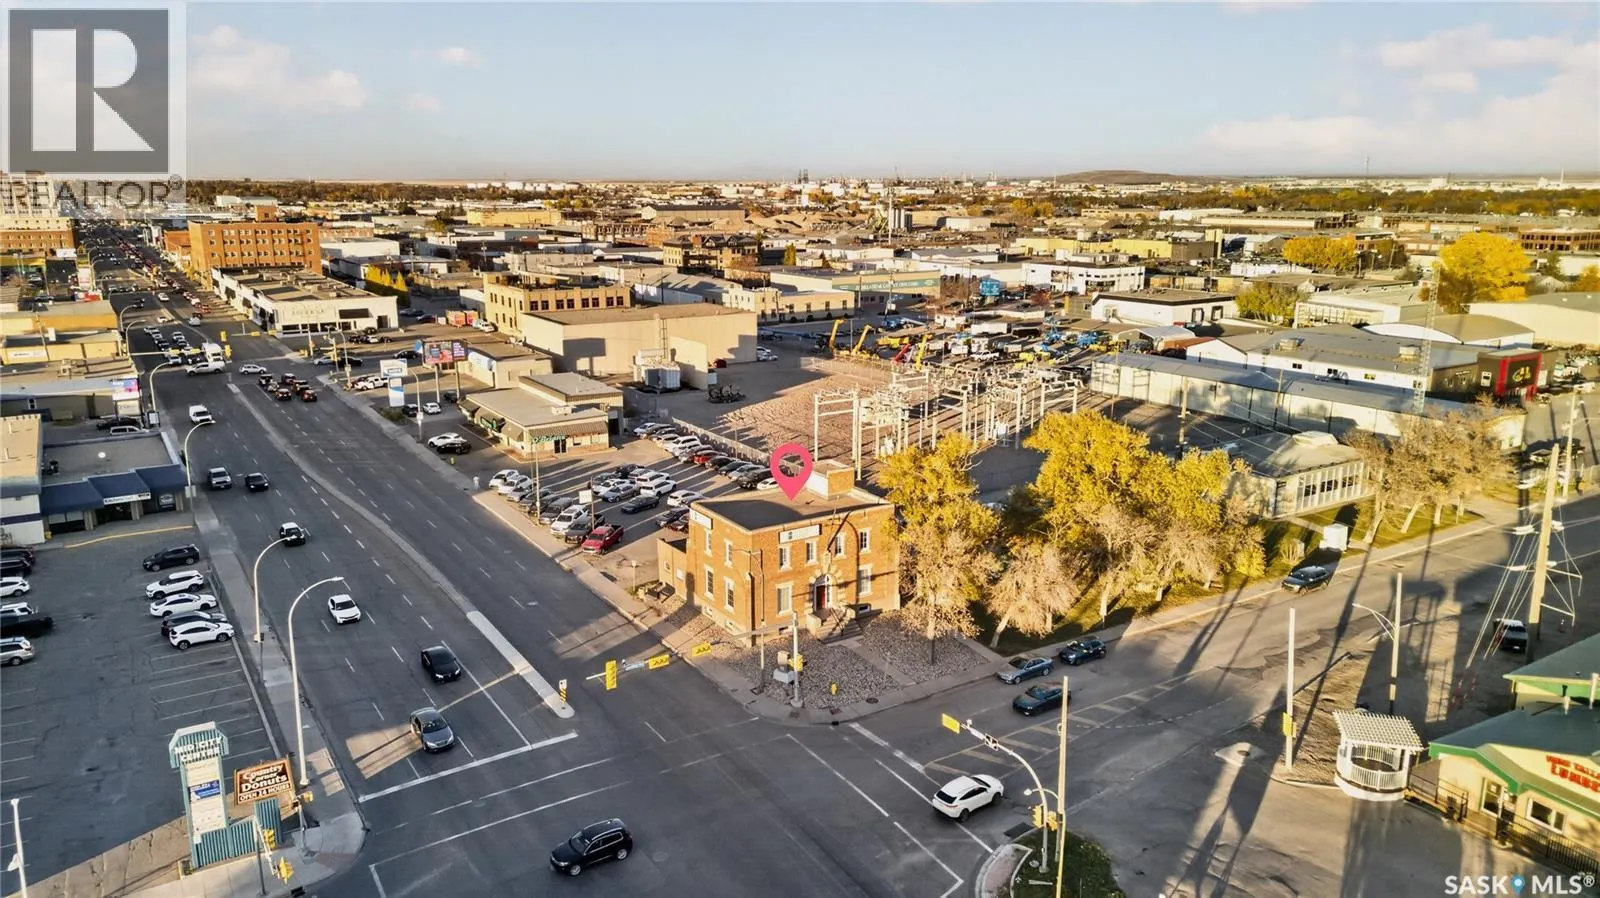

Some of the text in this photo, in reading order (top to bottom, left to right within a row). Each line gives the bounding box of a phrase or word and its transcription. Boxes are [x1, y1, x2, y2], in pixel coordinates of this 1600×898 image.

[243, 764, 284, 780] Country
[249, 772, 278, 784] Corner
[241, 775, 288, 792] Donuts
[240, 791, 258, 801] OPEN
[269, 783, 290, 794] HOURS
